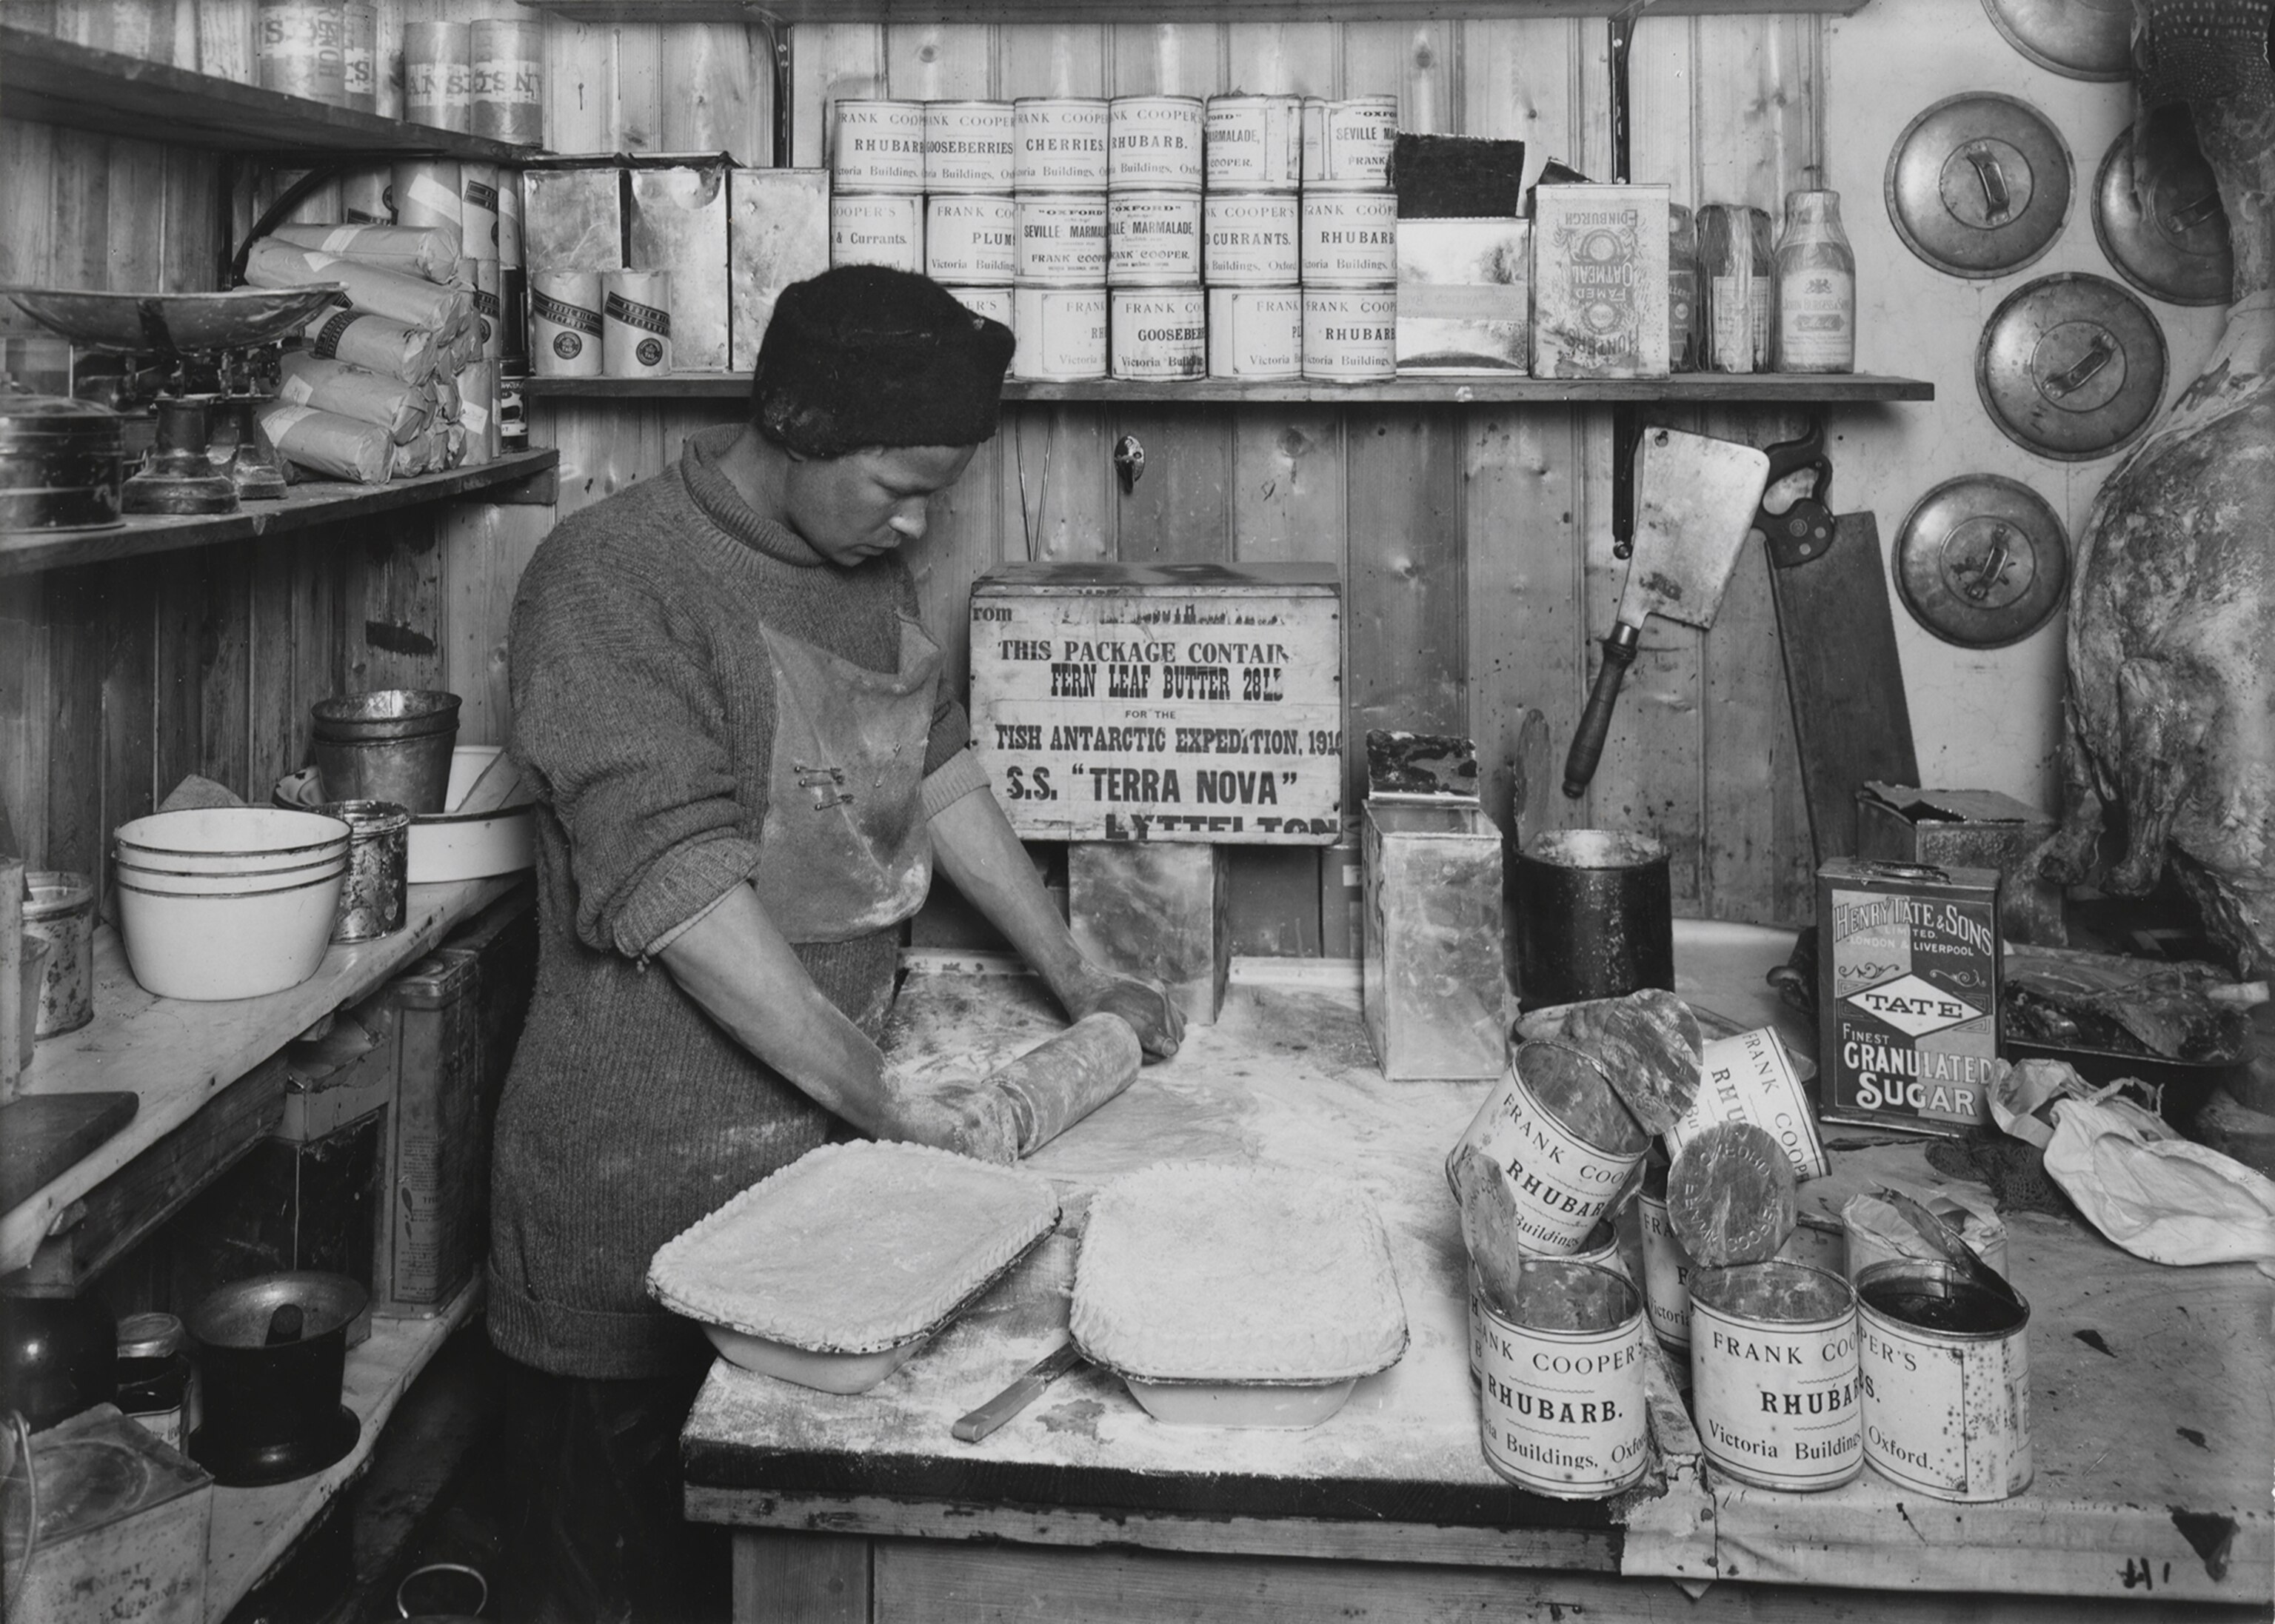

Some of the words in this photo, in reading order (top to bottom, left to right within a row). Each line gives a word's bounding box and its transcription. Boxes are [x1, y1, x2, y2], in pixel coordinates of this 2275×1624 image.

[1336, 127, 1377, 141] SEVILLE
[936, 206, 984, 218] FRANK
[1565, 208, 1638, 228] EDINBURGH
[1023, 224, 1061, 238] SEVILLE
[1213, 233, 1292, 245] CURRANTS.
[931, 258, 967, 270] Victoria
[1571, 262, 1632, 287] OATMEAL
[1126, 303, 1175, 314] FRANK
[1121, 355, 1161, 367] Victoria
[1249, 355, 1290, 366] Victoria
[998, 640, 1052, 661] THIS
[1063, 641, 1176, 663] PACKAGE
[1050, 663, 1097, 698] FERN
[1109, 664, 1151, 698] LEAF
[1163, 666, 1230, 701] BUTTER
[1125, 710, 1148, 719] FOR
[1156, 711, 1177, 720] THE
[995, 724, 1043, 751] TISH
[1050, 726, 1166, 753] ANTARCTIC
[1175, 727, 1303, 756] EXPEDITION,
[1006, 765, 1058, 801] S.S.
[1834, 898, 1890, 943] HENRY
[1887, 895, 1934, 928] TATE
[1945, 904, 1993, 957] SONS
[1851, 935, 1895, 949] LONDON
[1913, 941, 1975, 958] LIVERPOOL
[1865, 993, 1964, 1020] TATE
[1843, 1022, 1890, 1045] FINEST
[1743, 1033, 1779, 1095] FRANK
[1843, 1041, 1994, 1086] GRANULATED
[1855, 1071, 1977, 1117] SUGAR
[1503, 1092, 1566, 1165] FRANK
[1712, 1331, 1803, 1365] FRANK
[1488, 1371, 1623, 1424] RHUBARB.
[1506, 1432, 1599, 1471] Buildings,
[1708, 1419, 1778, 1458] Victoria
[1868, 1425, 1933, 1471] Oxford.
